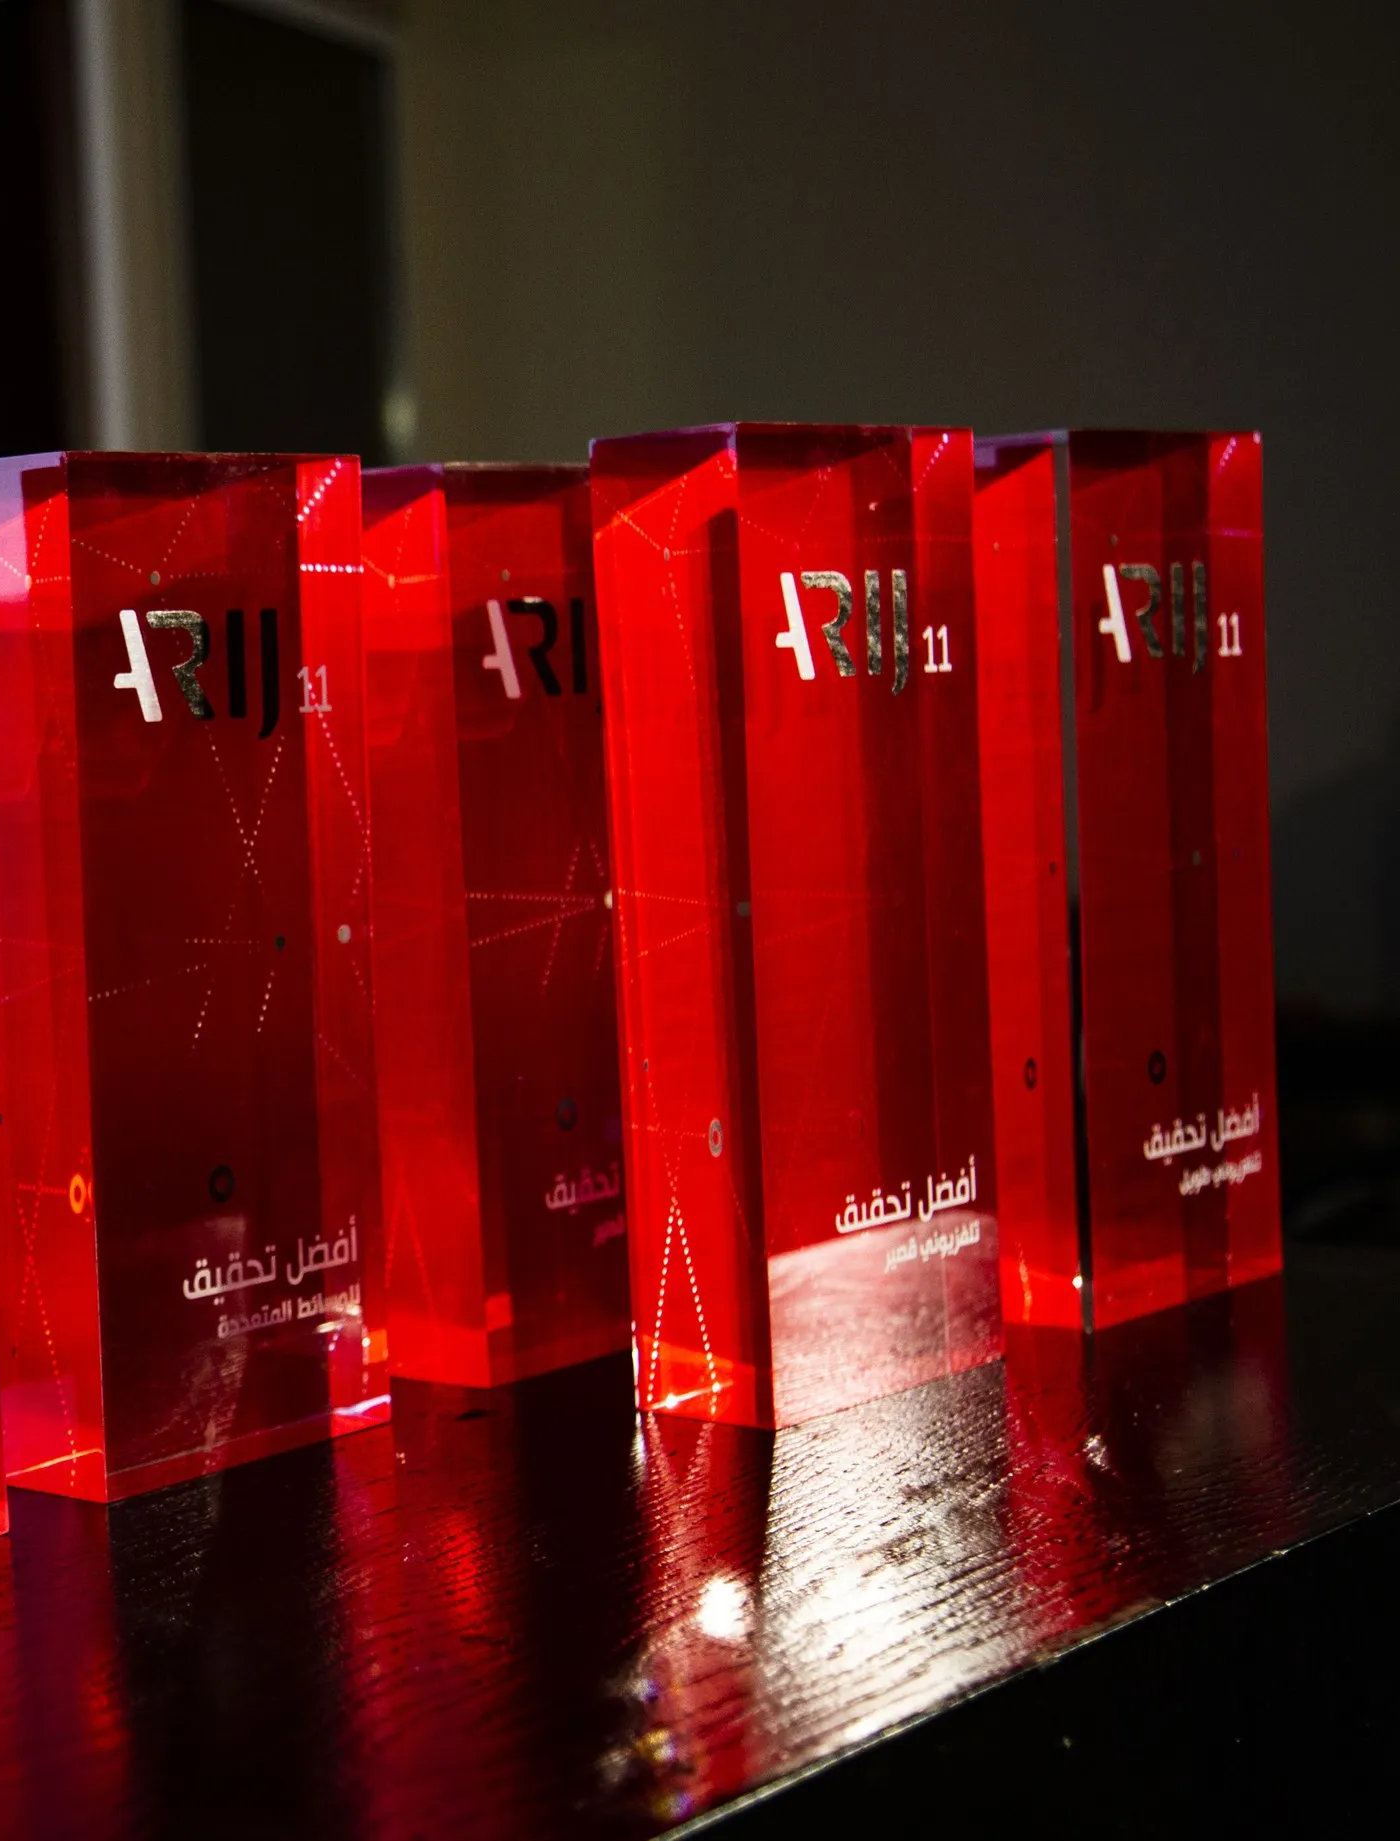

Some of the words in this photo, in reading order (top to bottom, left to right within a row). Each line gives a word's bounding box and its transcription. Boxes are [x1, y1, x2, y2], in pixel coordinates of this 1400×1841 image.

[775, 568, 909, 696] ARIJ
[922, 624, 952, 673] 11
[1098, 560, 1206, 675] ARIJ
[1217, 612, 1242, 657] 11
[113, 608, 280, 740] ARIJ
[297, 664, 332, 713] 11
[482, 595, 603, 716] ARI
[835, 1181, 912, 1239] تحقيق
[918, 1154, 977, 1223] أفضل
[182, 1245, 277, 1305] تحقيق
[286, 1215, 358, 1285] أفضل
[919, 1219, 980, 1263] تلفزيوني
[217, 1299, 292, 1339] المتعددة
